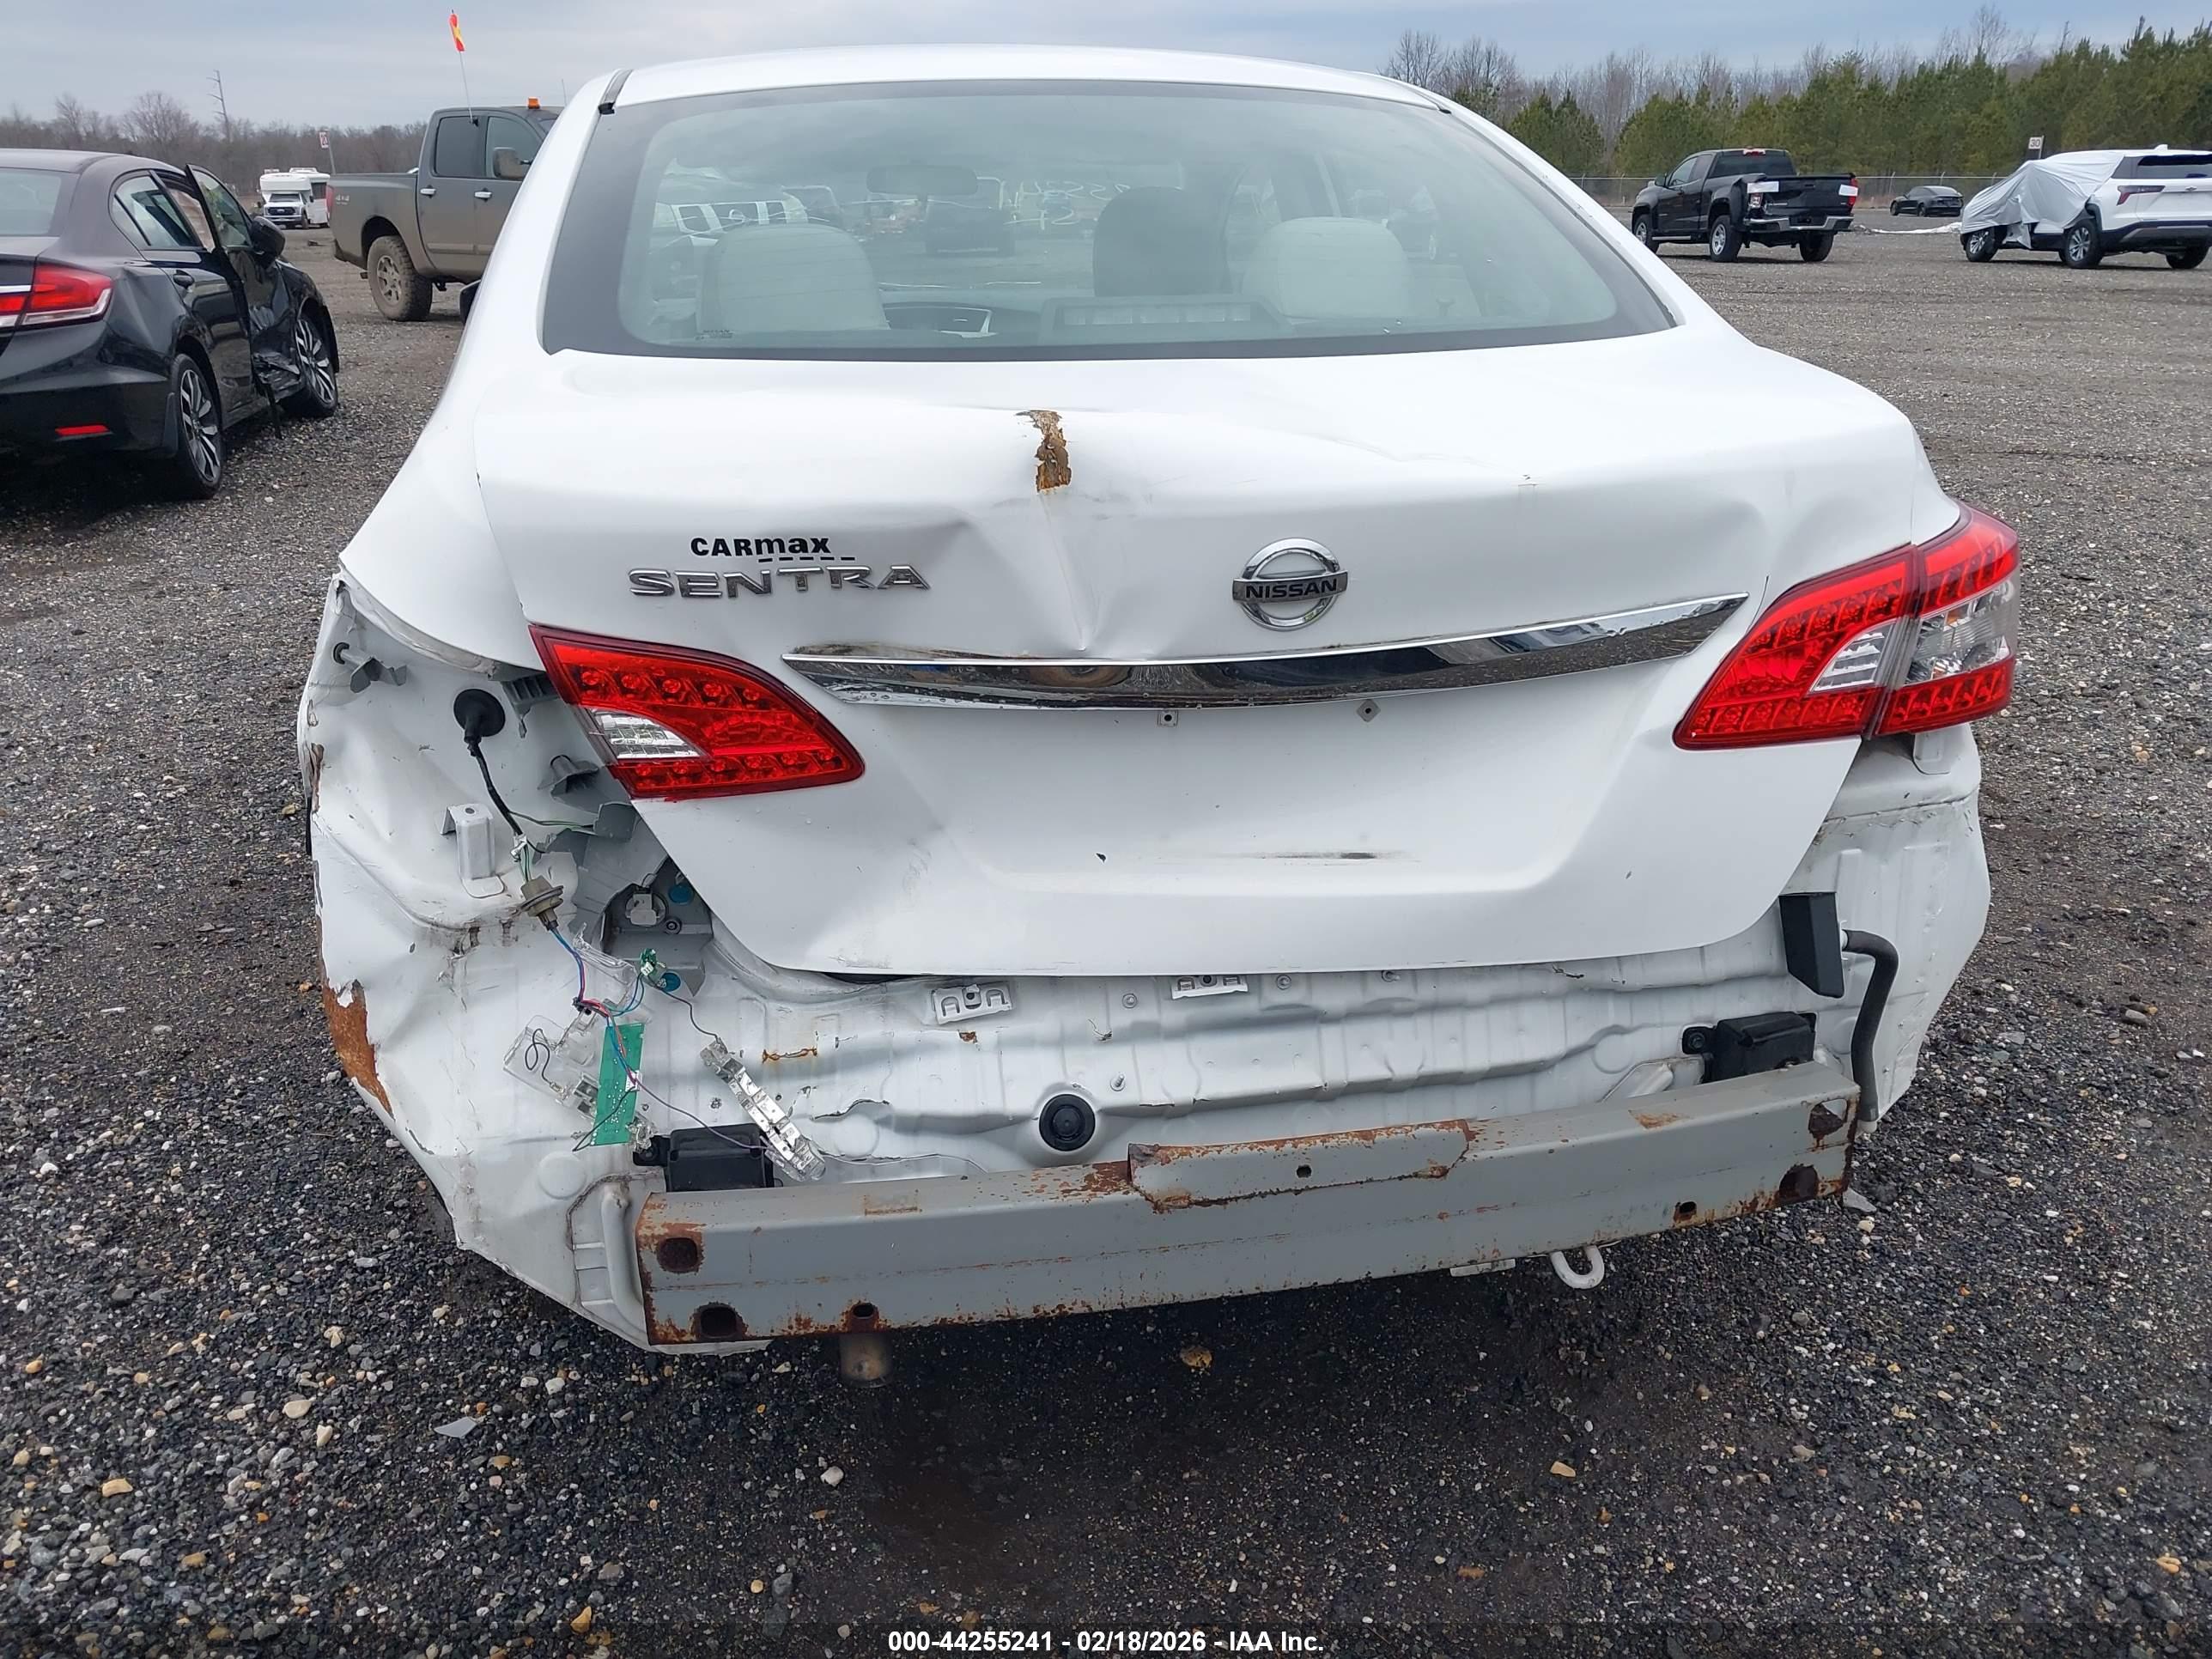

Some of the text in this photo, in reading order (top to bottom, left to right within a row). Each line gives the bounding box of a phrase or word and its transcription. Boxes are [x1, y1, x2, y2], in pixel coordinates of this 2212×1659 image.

[2030, 138, 2040, 148] 30
[629, 565, 931, 599] SENTRA
[1246, 579, 1337, 599] NISSAN
